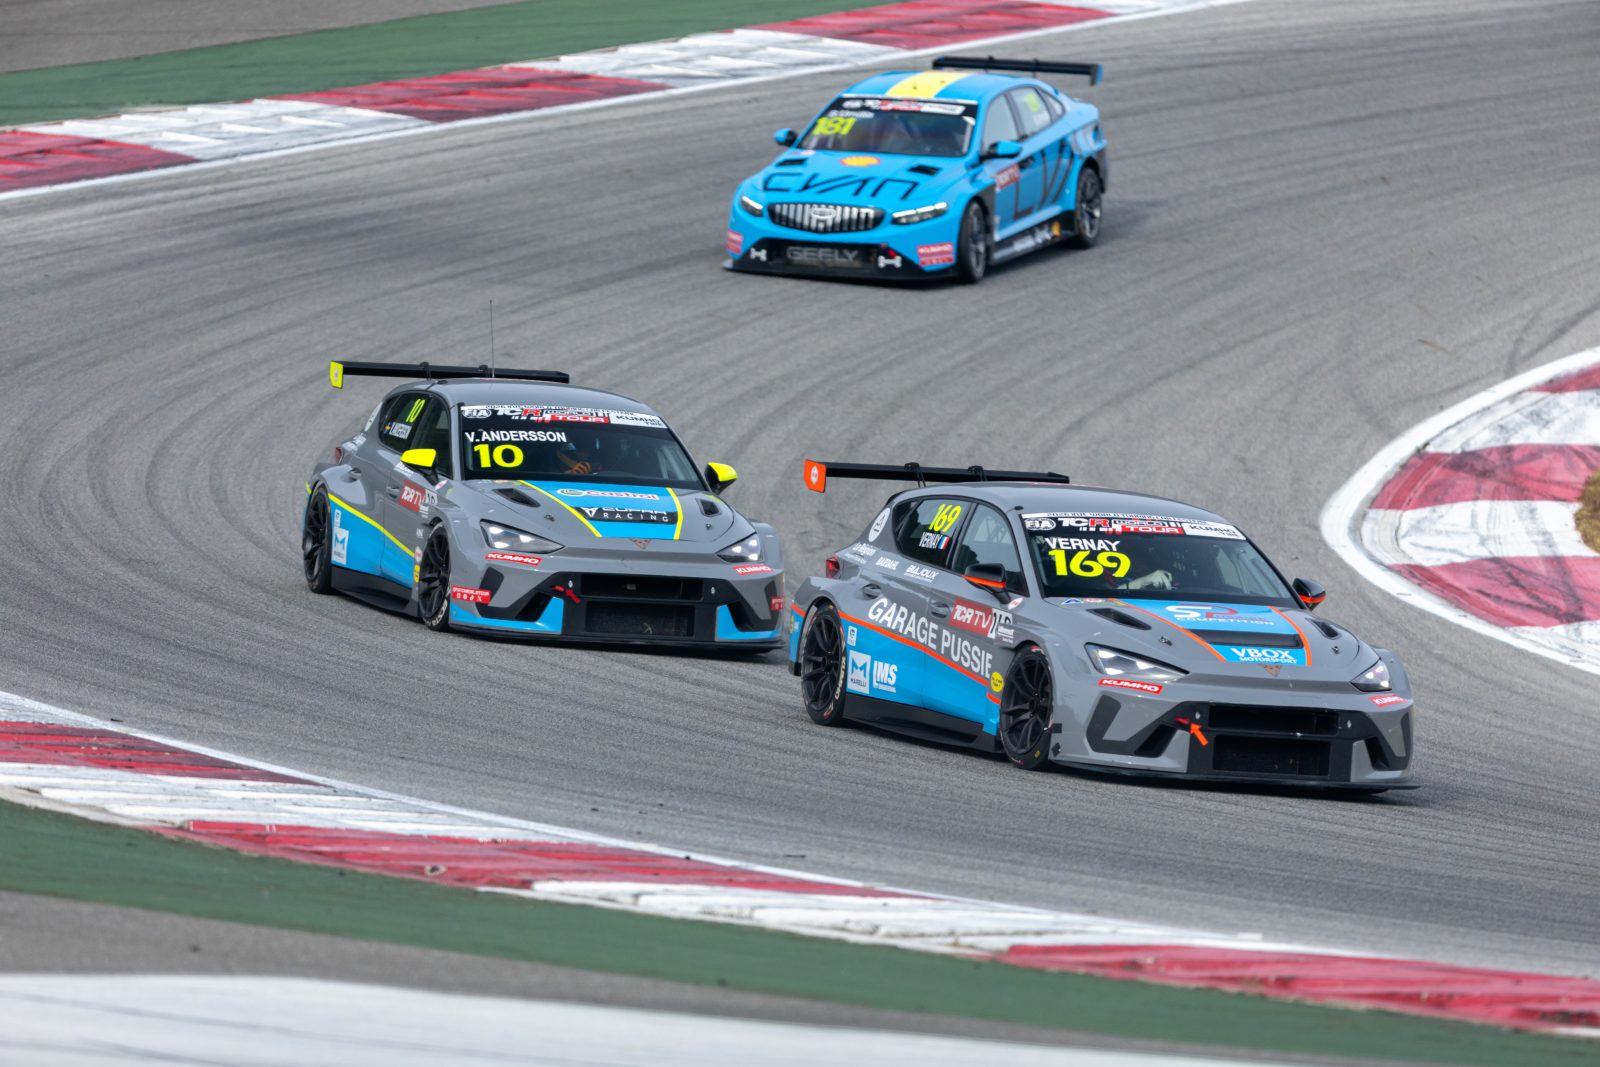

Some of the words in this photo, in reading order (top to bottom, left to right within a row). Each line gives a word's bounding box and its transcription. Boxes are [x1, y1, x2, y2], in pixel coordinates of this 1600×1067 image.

[812, 117, 857, 136] 181
[763, 172, 920, 200] CYAN
[786, 246, 859, 262] GEELY
[405, 398, 426, 423] 10
[463, 409, 492, 419] FIA
[497, 408, 542, 417] TCR
[557, 415, 606, 423] TOUR
[473, 443, 524, 468] 10
[585, 490, 660, 501] Castrol
[602, 512, 669, 523] RACING
[928, 503, 962, 533] 169
[1058, 518, 1110, 528] TCR
[1024, 518, 1056, 531] FIA
[1124, 526, 1181, 535] TOUR
[1189, 525, 1237, 534] KUMHO
[918, 532, 942, 549] VERNAY
[1044, 537, 1120, 552] VERNAY
[487, 553, 540, 565] KUMHO
[1048, 549, 1131, 578] 169
[735, 565, 773, 575] KUMHO
[953, 604, 975, 624] TCR
[1176, 616, 1276, 627] COMPETITION
[868, 597, 938, 651] GARAGE
[940, 629, 993, 679] PUSSIE
[1230, 647, 1297, 661] VBOX
[1239, 656, 1298, 665] MOTORSPORT
[1101, 679, 1160, 693] KUMHO
